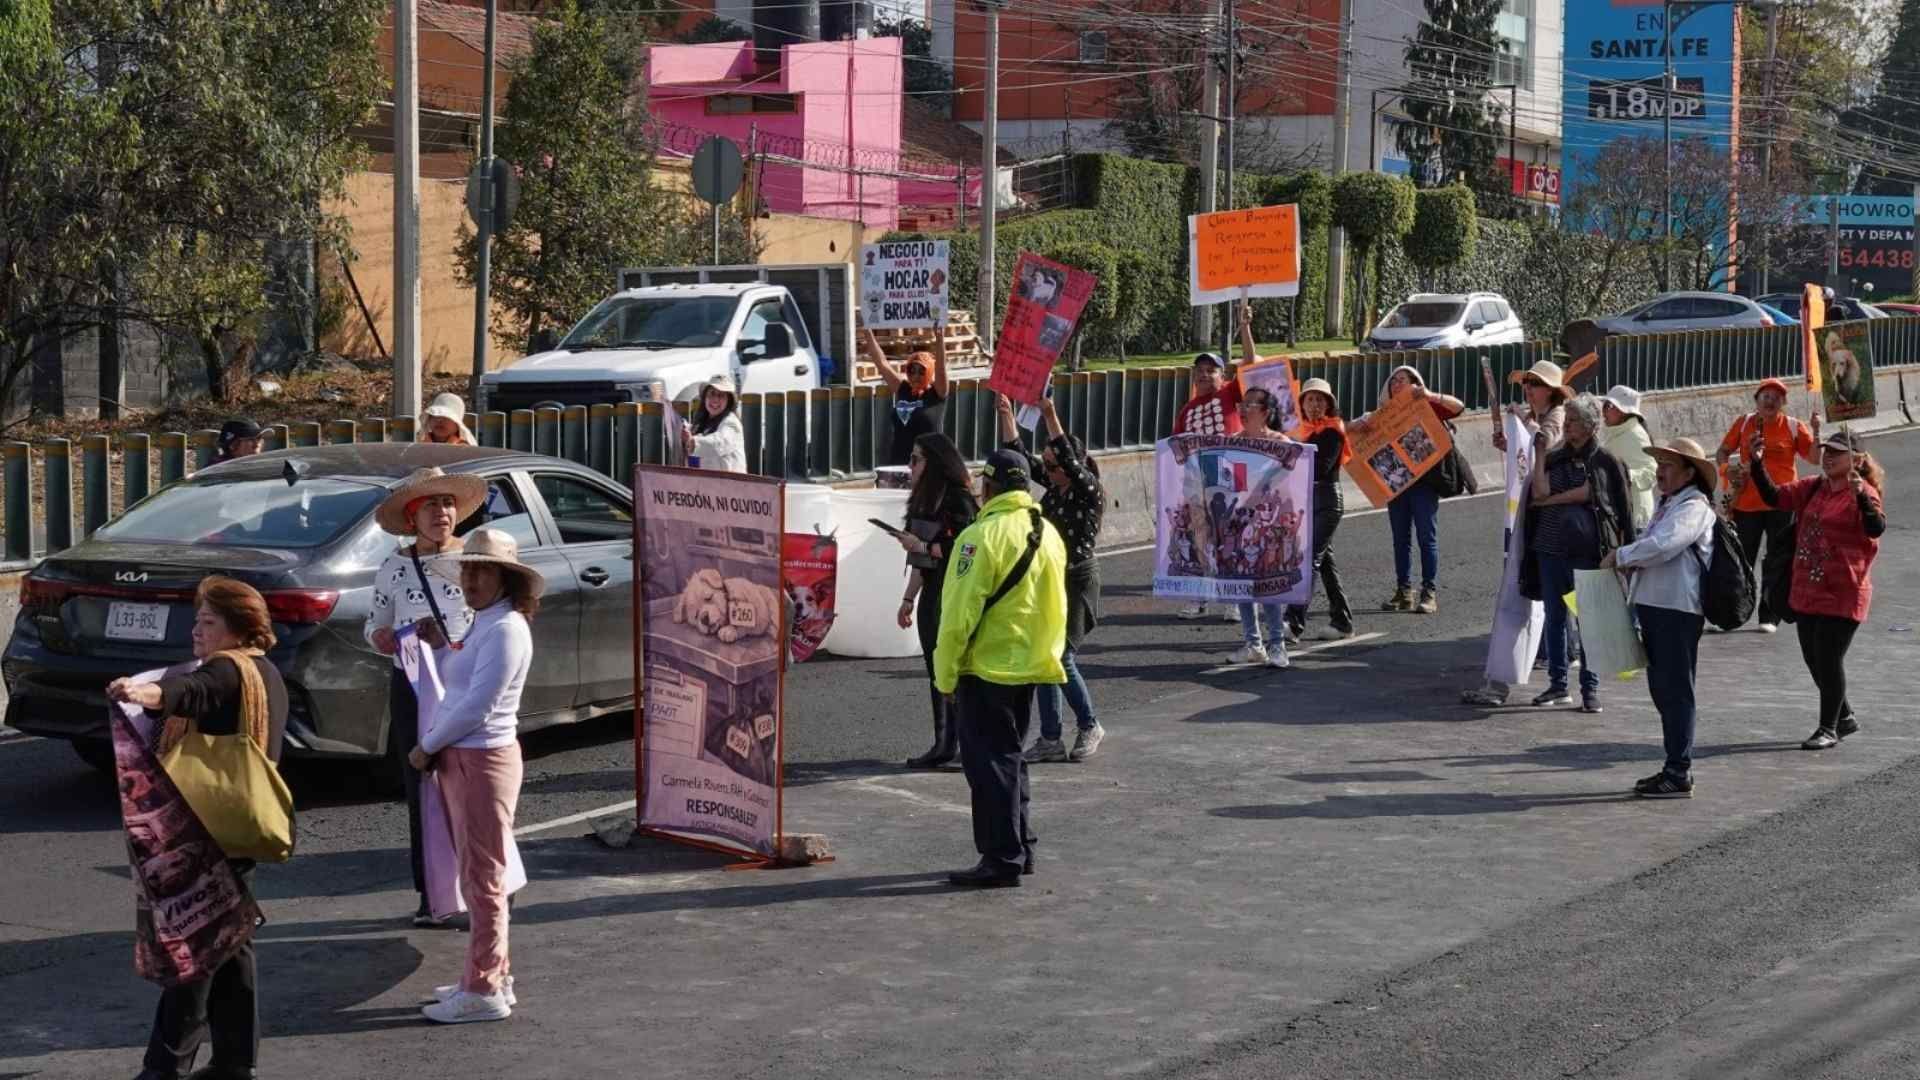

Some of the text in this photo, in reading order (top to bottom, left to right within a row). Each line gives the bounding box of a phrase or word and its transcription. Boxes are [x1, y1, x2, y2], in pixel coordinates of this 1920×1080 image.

[1636, 13, 1663, 31] EN
[1590, 38, 1709, 58] SANTA FE
[1858, 230, 1867, 240] Y
[1869, 231, 1903, 240] DEPA
[880, 243, 935, 259] NEGOCIO
[884, 269, 929, 290] HOGAR
[883, 302, 931, 321] BRUGADA
[652, 490, 664, 504] NI
[717, 496, 728, 511] NI
[115, 571, 148, 582] KIA
